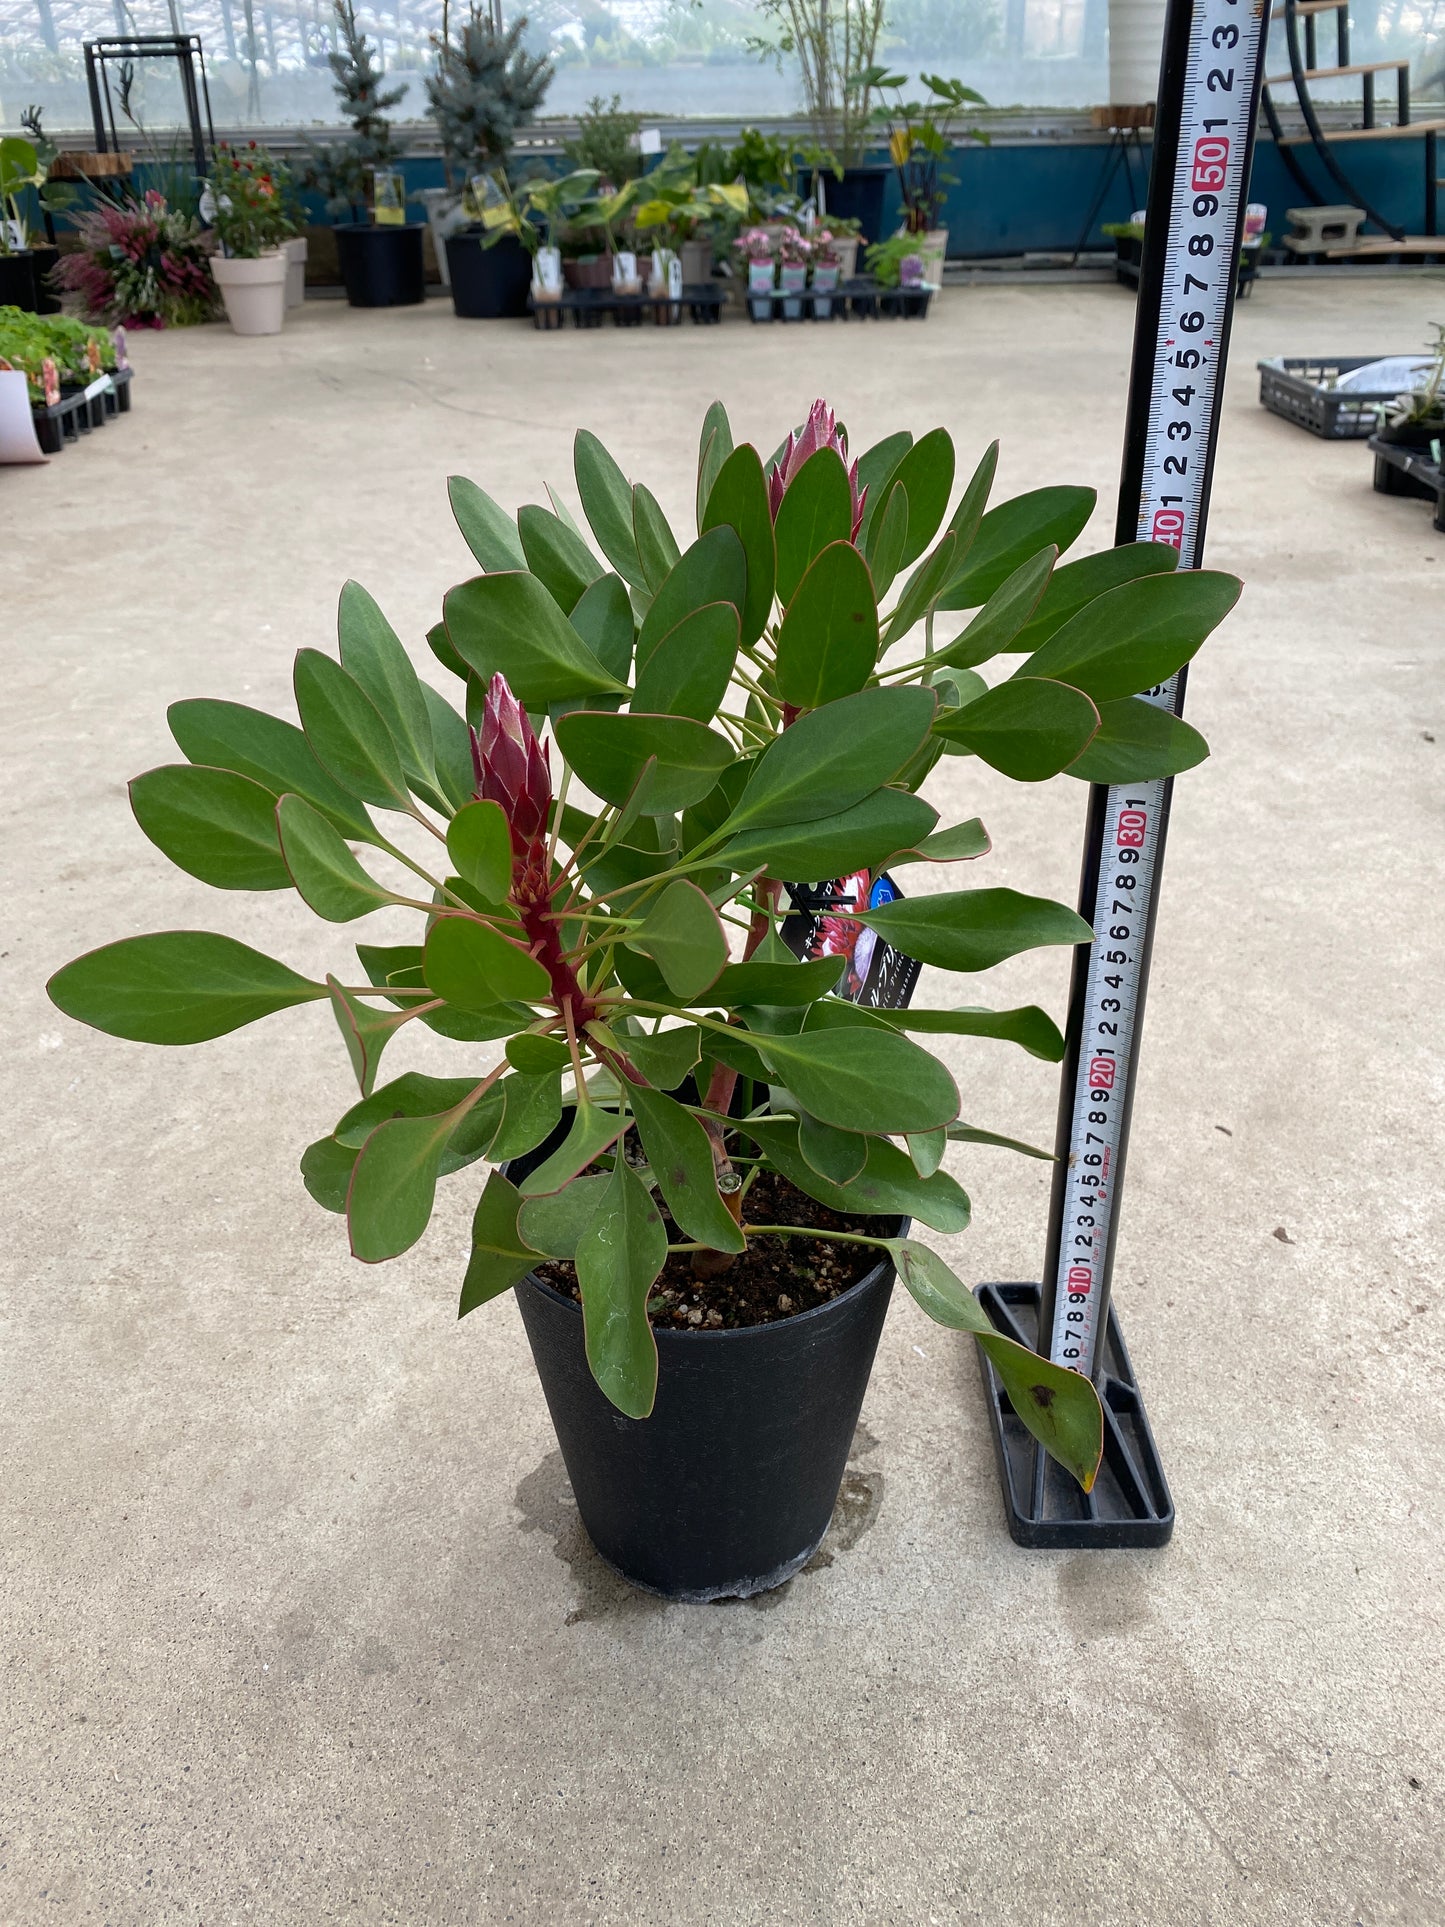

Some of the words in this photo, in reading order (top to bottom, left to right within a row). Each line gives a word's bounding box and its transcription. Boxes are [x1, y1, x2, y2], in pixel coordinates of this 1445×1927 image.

[1211, 24, 1239, 50] 3
[1206, 68, 1235, 92] 2
[1203, 118, 1229, 134] 1
[1194, 142, 1228, 185] 50
[1192, 193, 1219, 218] 9
[1188, 233, 1214, 257] 8
[1183, 273, 1209, 295] 7
[1179, 311, 1205, 333] 6
[1175, 349, 1201, 370] 5
[1171, 385, 1196, 407] 4
[1167, 420, 1192, 442] 3
[1164, 455, 1188, 476] 2
[1161, 495, 1183, 507] 1
[1125, 799, 1147, 809] 1
[1118, 813, 1145, 843] 30
[1118, 848, 1140, 864] 9
[1115, 874, 1137, 891] 8
[1112, 899, 1133, 915] 7
[1109, 925, 1130, 941] 6
[1106, 950, 1127, 965] 5
[1104, 974, 1124, 990] 4
[1100, 998, 1121, 1013] 3
[1097, 1021, 1118, 1037] 2
[1095, 1048, 1115, 1057] 1
[1090, 1059, 1115, 1085] 20
[1090, 1089, 1110, 1103] 9
[1087, 1111, 1108, 1125] 8
[1085, 1132, 1105, 1145] 7
[1083, 1153, 1103, 1167] 6
[1081, 1174, 1100, 1187] 5
[1079, 1195, 1098, 1208] 4
[1076, 1215, 1095, 1228] 3
[1074, 1234, 1093, 1248] 2
[1073, 1257, 1091, 1265] 1
[1069, 1269, 1090, 1288] 10
[1068, 1292, 1087, 1304] 9
[1066, 1311, 1084, 1323] 8
[1064, 1329, 1082, 1341] 7
[1062, 1347, 1080, 1359] 6
